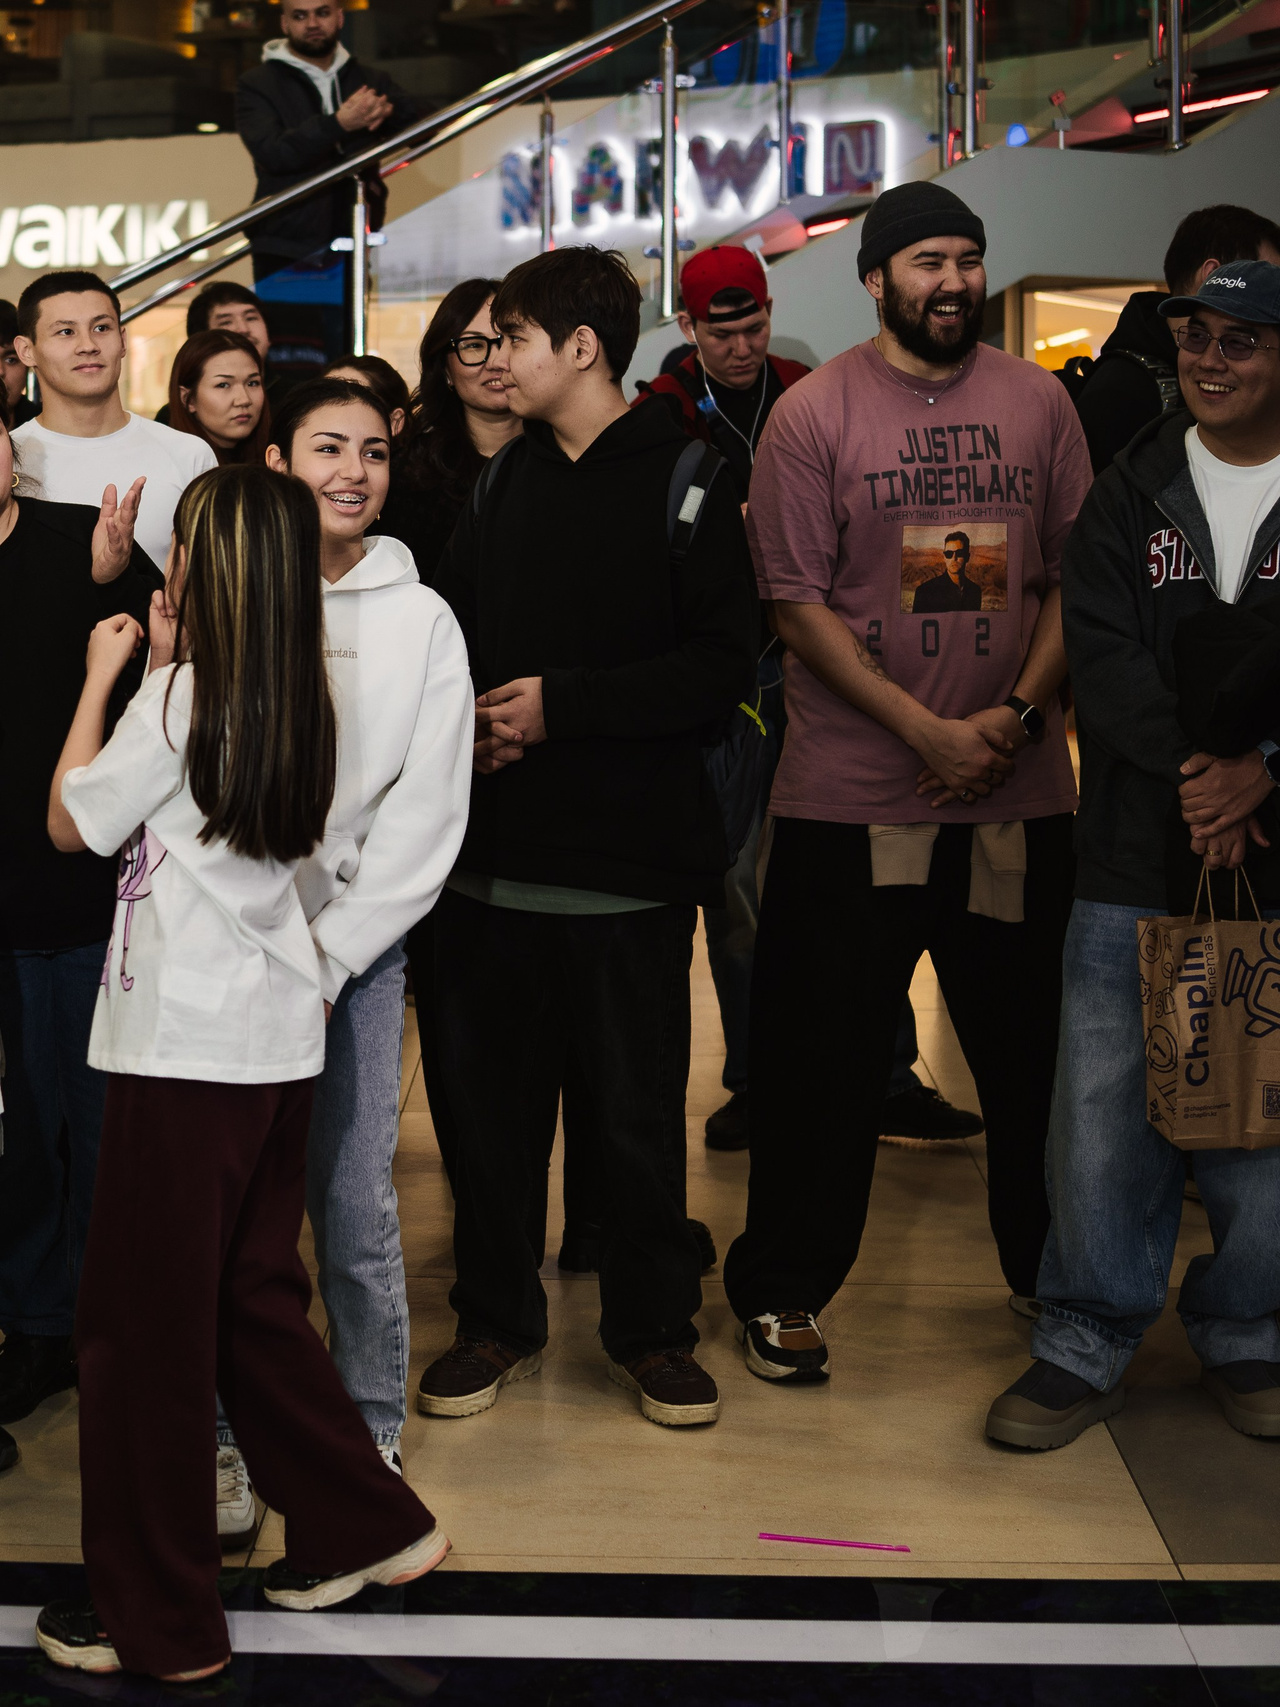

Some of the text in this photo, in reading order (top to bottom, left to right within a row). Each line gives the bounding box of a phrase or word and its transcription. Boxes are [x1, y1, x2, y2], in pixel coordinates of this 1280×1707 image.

[1206, 276, 1247, 289] Google
[898, 424, 1002, 464] JUSTIN
[864, 464, 1033, 511] TIMBERLAKE
[883, 511, 939, 522] EVERYTHING
[947, 508, 992, 520] THOUGHT
[995, 507, 1004, 517] IT
[1005, 507, 1026, 517] WAS
[322, 647, 358, 659] ountain
[1203, 935, 1218, 998] cinemas
[1177, 936, 1214, 1087] Chaplin
